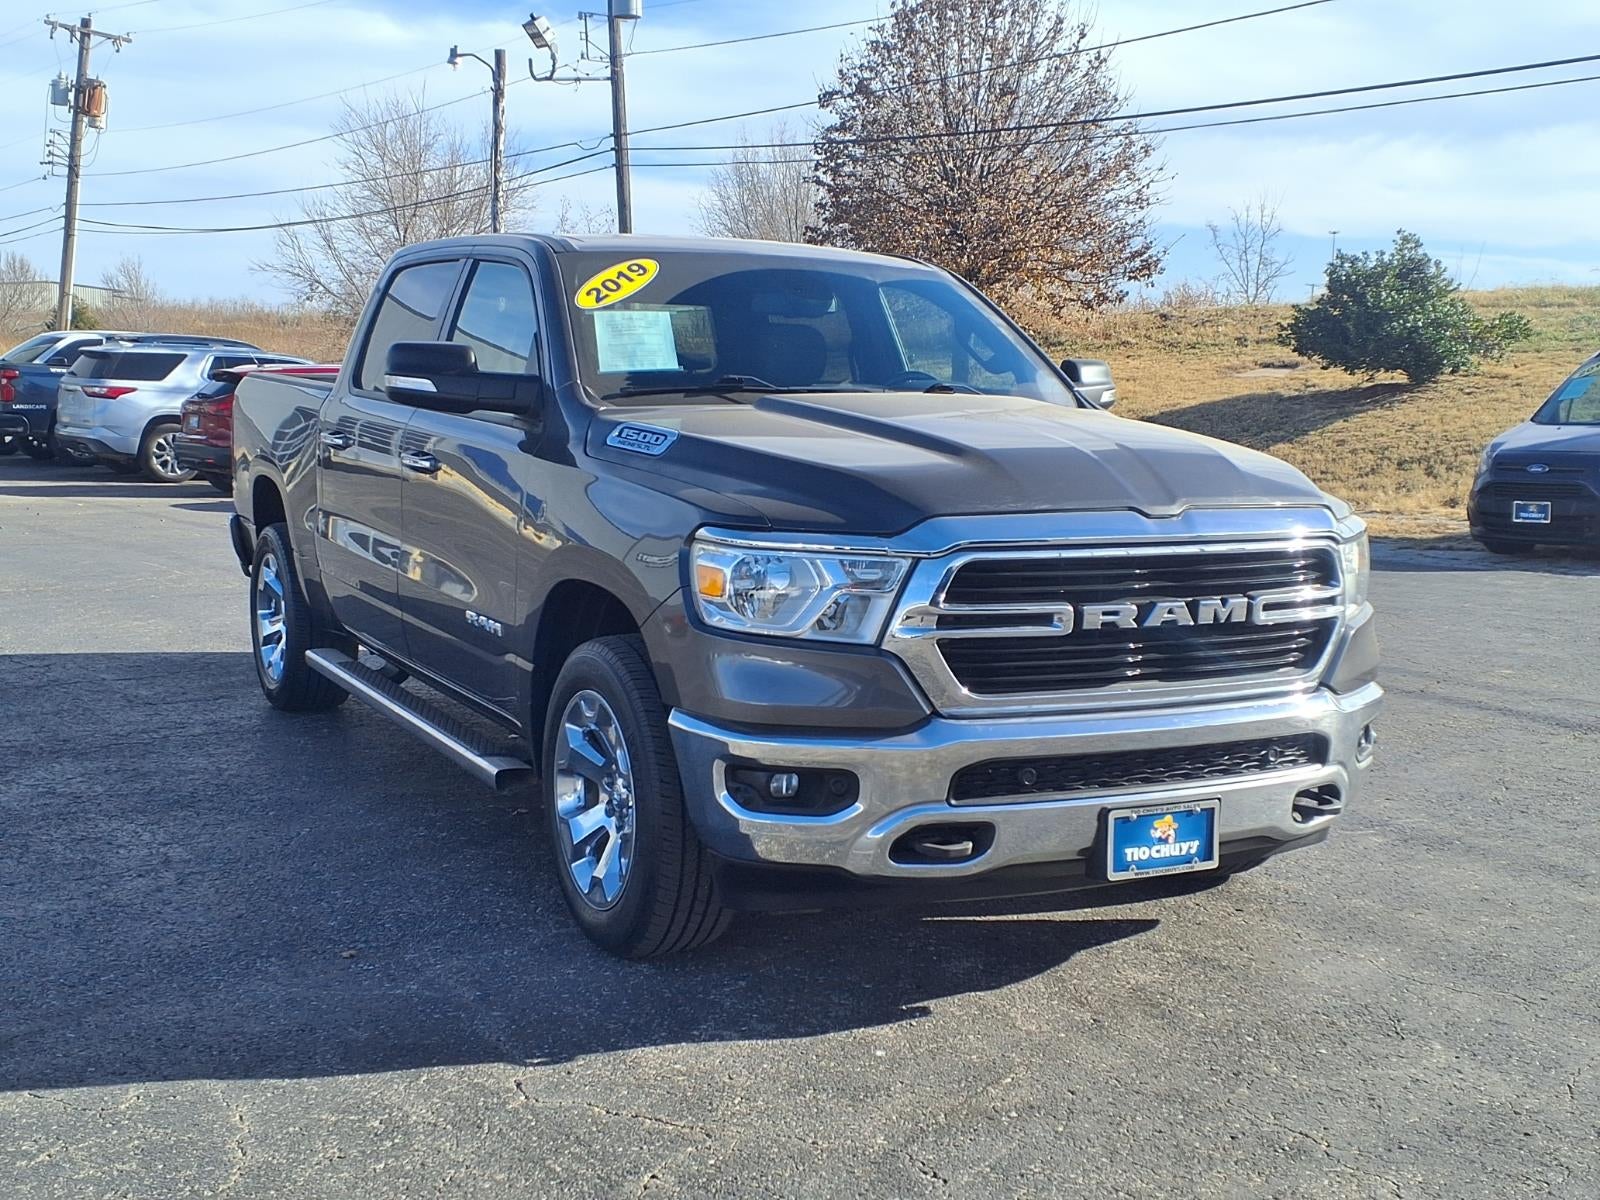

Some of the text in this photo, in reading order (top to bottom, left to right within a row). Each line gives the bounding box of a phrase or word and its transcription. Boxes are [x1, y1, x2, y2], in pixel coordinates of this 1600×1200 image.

[585, 262, 649, 304] 2019
[621, 428, 666, 445] 1500
[1081, 594, 1248, 630] RAM
[1124, 839, 1200, 862] TIO CHUY'S
